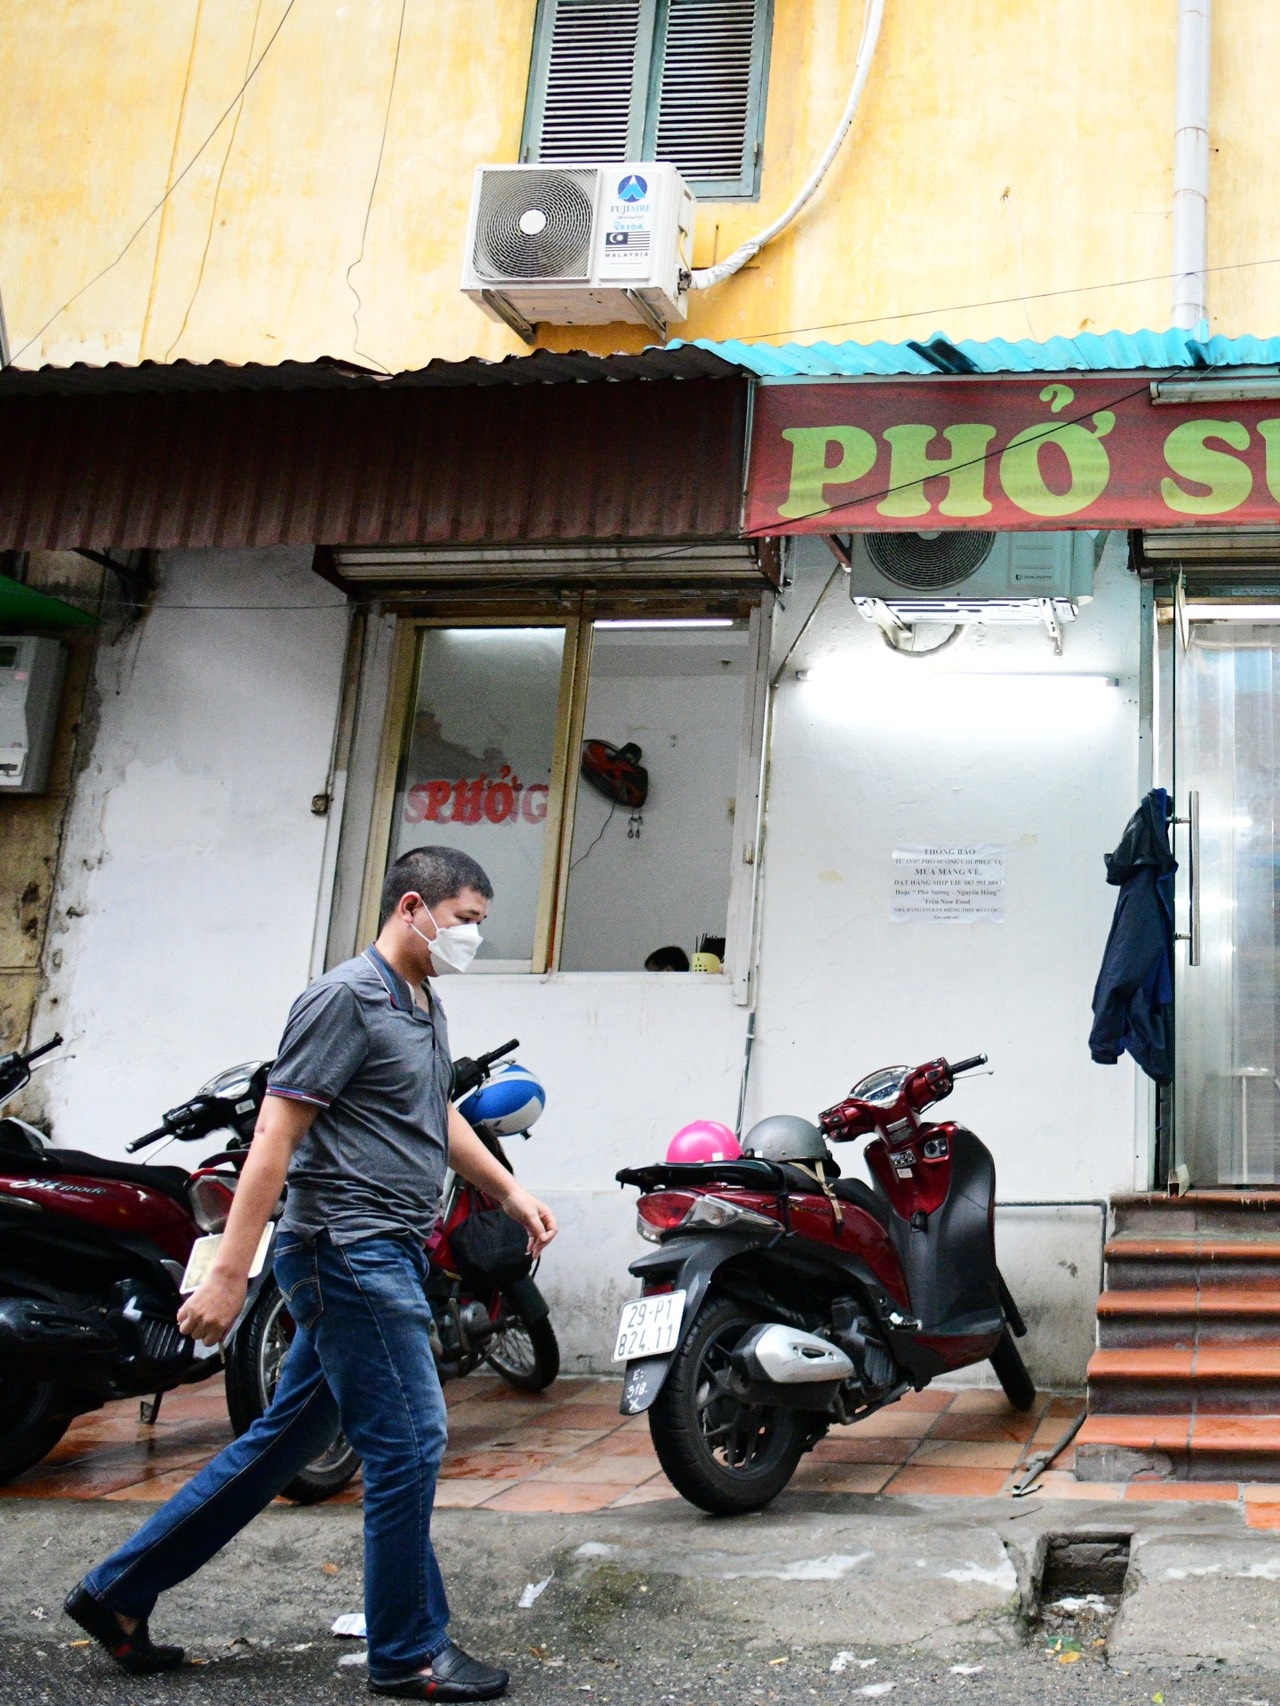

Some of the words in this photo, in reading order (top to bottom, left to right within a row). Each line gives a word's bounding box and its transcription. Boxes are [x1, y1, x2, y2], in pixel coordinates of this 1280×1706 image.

[777, 384, 1116, 519] PHỞ
[924, 846, 955, 855] THÔNG
[957, 846, 976, 855] BÁO
[627, 1298, 673, 1329] 29-P1
[618, 1324, 673, 1357] 824.11
